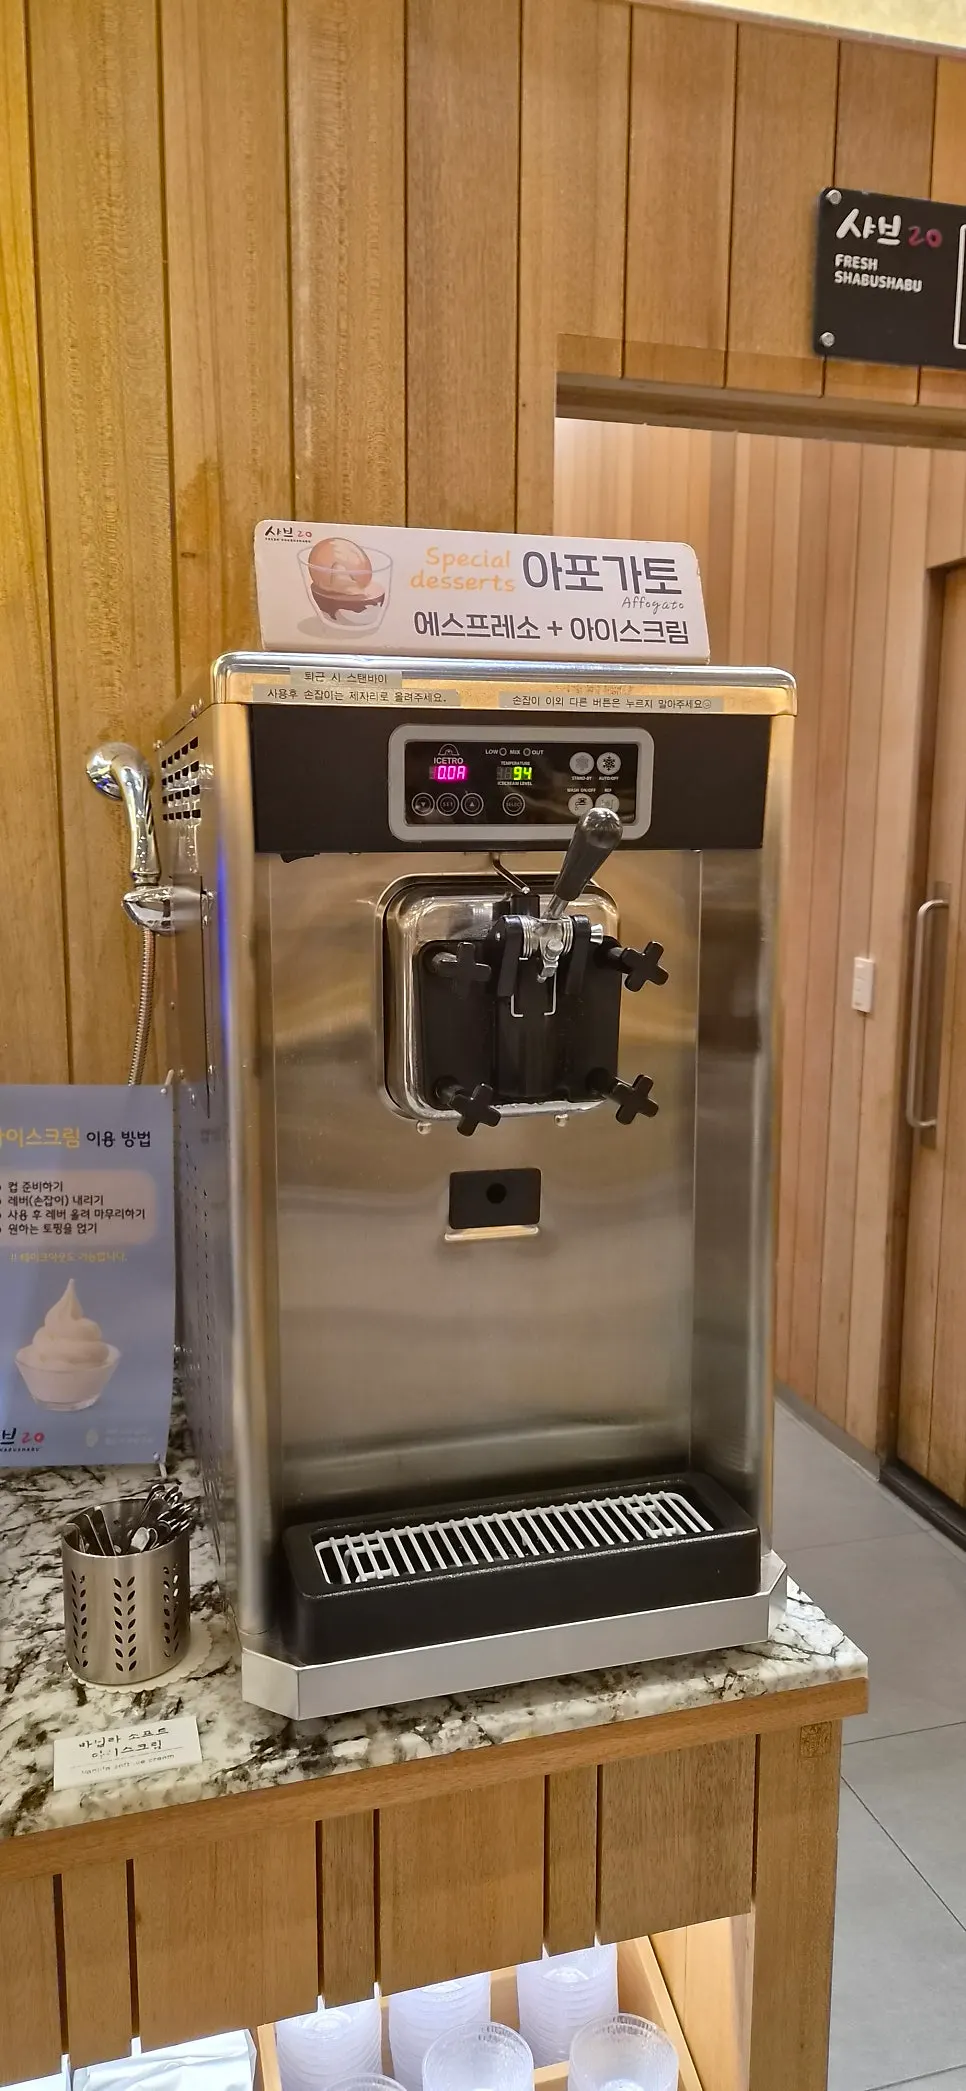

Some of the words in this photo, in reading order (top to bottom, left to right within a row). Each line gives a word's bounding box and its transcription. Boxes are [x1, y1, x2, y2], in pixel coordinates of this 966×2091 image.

[836, 208, 901, 246] 샤브
[908, 226, 942, 248] 20
[835, 254, 878, 271] FRESH
[834, 270, 923, 293] SHABUSHABU
[264, 525, 294, 538] 샤브
[297, 530, 313, 538] 20
[425, 547, 511, 574] Special
[522, 550, 683, 595] 아포가토
[410, 570, 516, 593] desserts
[621, 596, 685, 615] Affogato
[413, 611, 541, 640] 에스프레소
[547, 620, 563, 637] +
[570, 617, 690, 645] 아이스크림
[303, 671, 326, 682] 퇴근
[331, 673, 341, 682] 시
[346, 674, 388, 684] 스탠바이
[267, 689, 299, 700] 사용후
[303, 690, 344, 701] 손잡이는
[348, 690, 390, 702] 제자리로
[394, 692, 447, 703] 올려주세요.
[512, 695, 541, 706] 손잡이
[545, 697, 564, 707] 이외
[569, 697, 588, 707] 다른
[592, 698, 621, 708] 버튼은
[625, 698, 654, 709] 누르지
[658, 699, 703, 710] 말아주세요
[433, 757, 465, 765] ICETRO
[513, 766, 533, 781] 94
[86, 1131, 116, 1148] 이용
[121, 1131, 151, 1148] 방법
[8, 1181, 18, 1193] 컵
[22, 1181, 63, 1193] 준비하기
[8, 1195, 69, 1207] 레버(손잡이)
[72, 1195, 104, 1206] 내리기
[8, 1209, 28, 1221] 사용
[32, 1210, 42, 1220] 후
[45, 1209, 66, 1220] 레버
[70, 1209, 91, 1220] 올려
[94, 1208, 146, 1220] 마무리하기
[8, 1223, 39, 1235] 원하는
[43, 1223, 73, 1235] 토핑을
[21, 1431, 45, 1444] 20
[128, 1727, 169, 1741] 소프트
